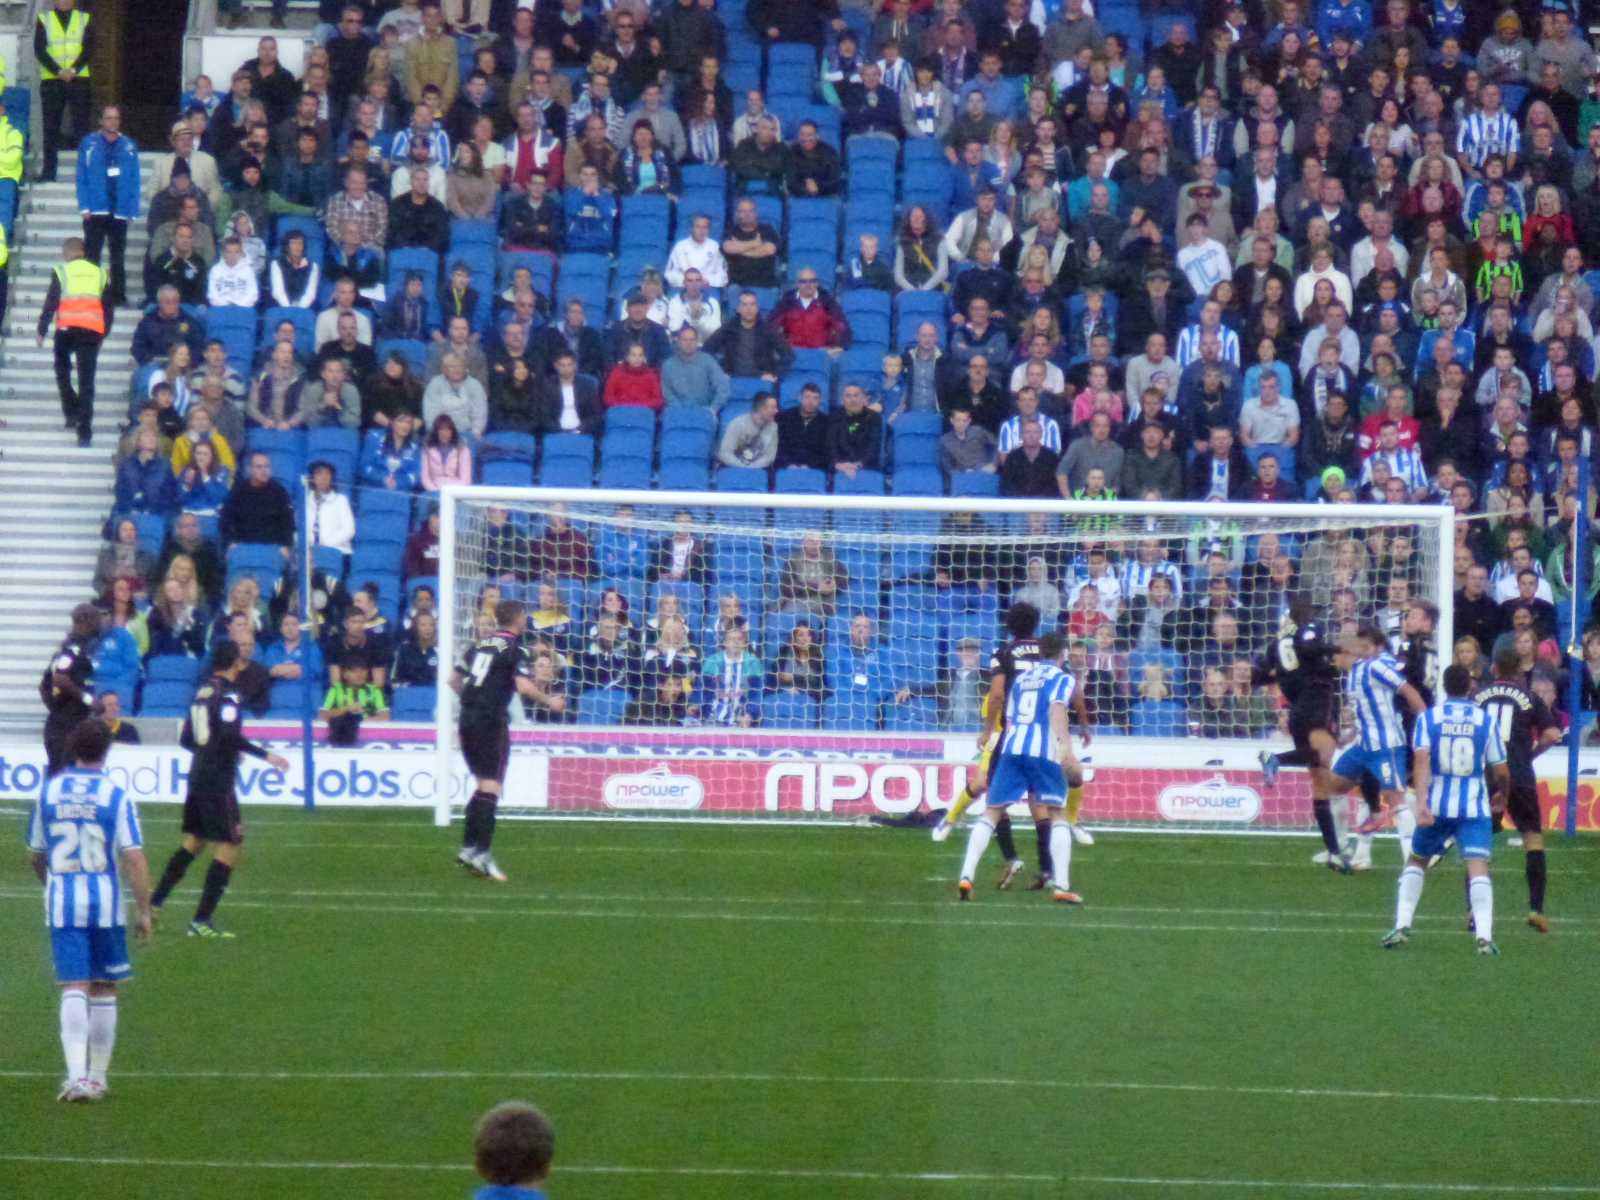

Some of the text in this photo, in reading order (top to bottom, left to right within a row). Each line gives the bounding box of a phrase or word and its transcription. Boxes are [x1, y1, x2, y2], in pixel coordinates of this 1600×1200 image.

[1015, 690, 1038, 725] 9
[1441, 722, 1475, 736] DICKER
[1439, 736, 1475, 776] 18
